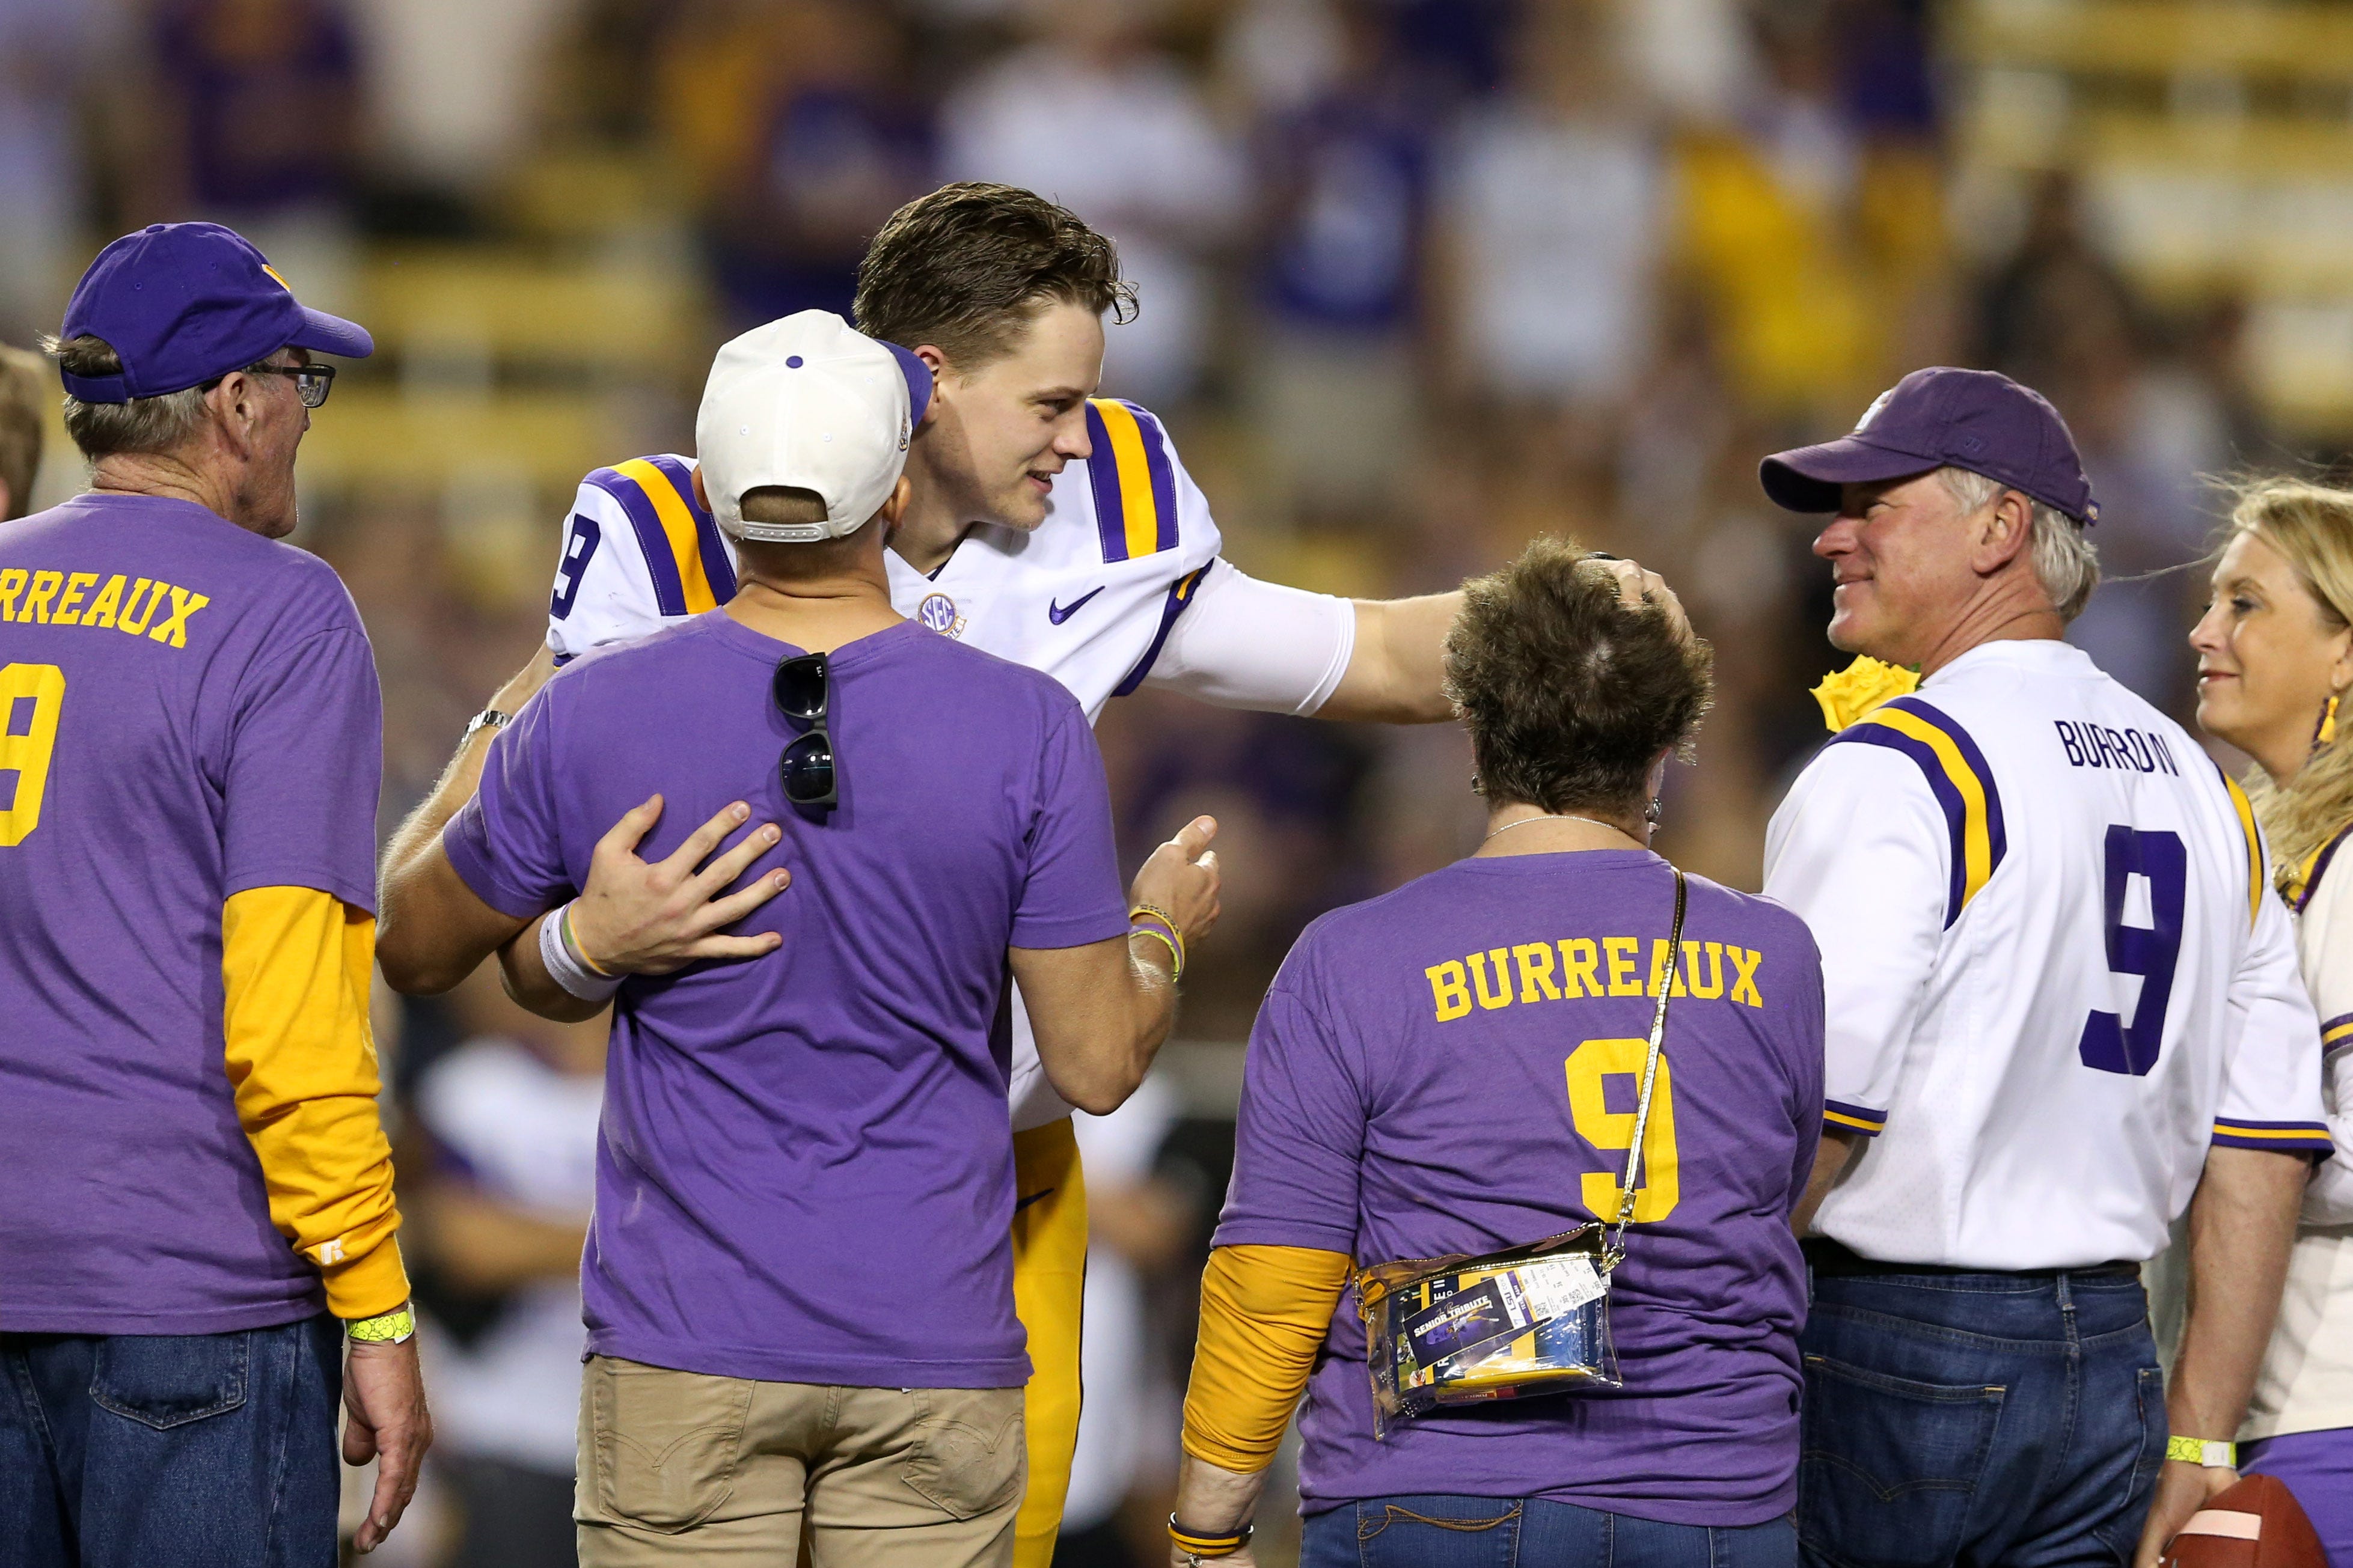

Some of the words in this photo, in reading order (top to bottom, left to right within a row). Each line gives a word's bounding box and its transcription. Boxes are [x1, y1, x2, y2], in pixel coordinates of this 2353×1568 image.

[550, 514, 601, 620] 9
[922, 595, 955, 632] SEC
[2054, 720, 2179, 776] BURROW
[1425, 937, 1763, 1023] BURREAUX
[2078, 824, 2186, 1076] 9
[1564, 1038, 1679, 1224] 9
[1413, 1314, 1448, 1338] SENIOR
[1449, 1295, 1489, 1318] TRIBUTE
[1504, 1292, 1516, 1311] LSU
